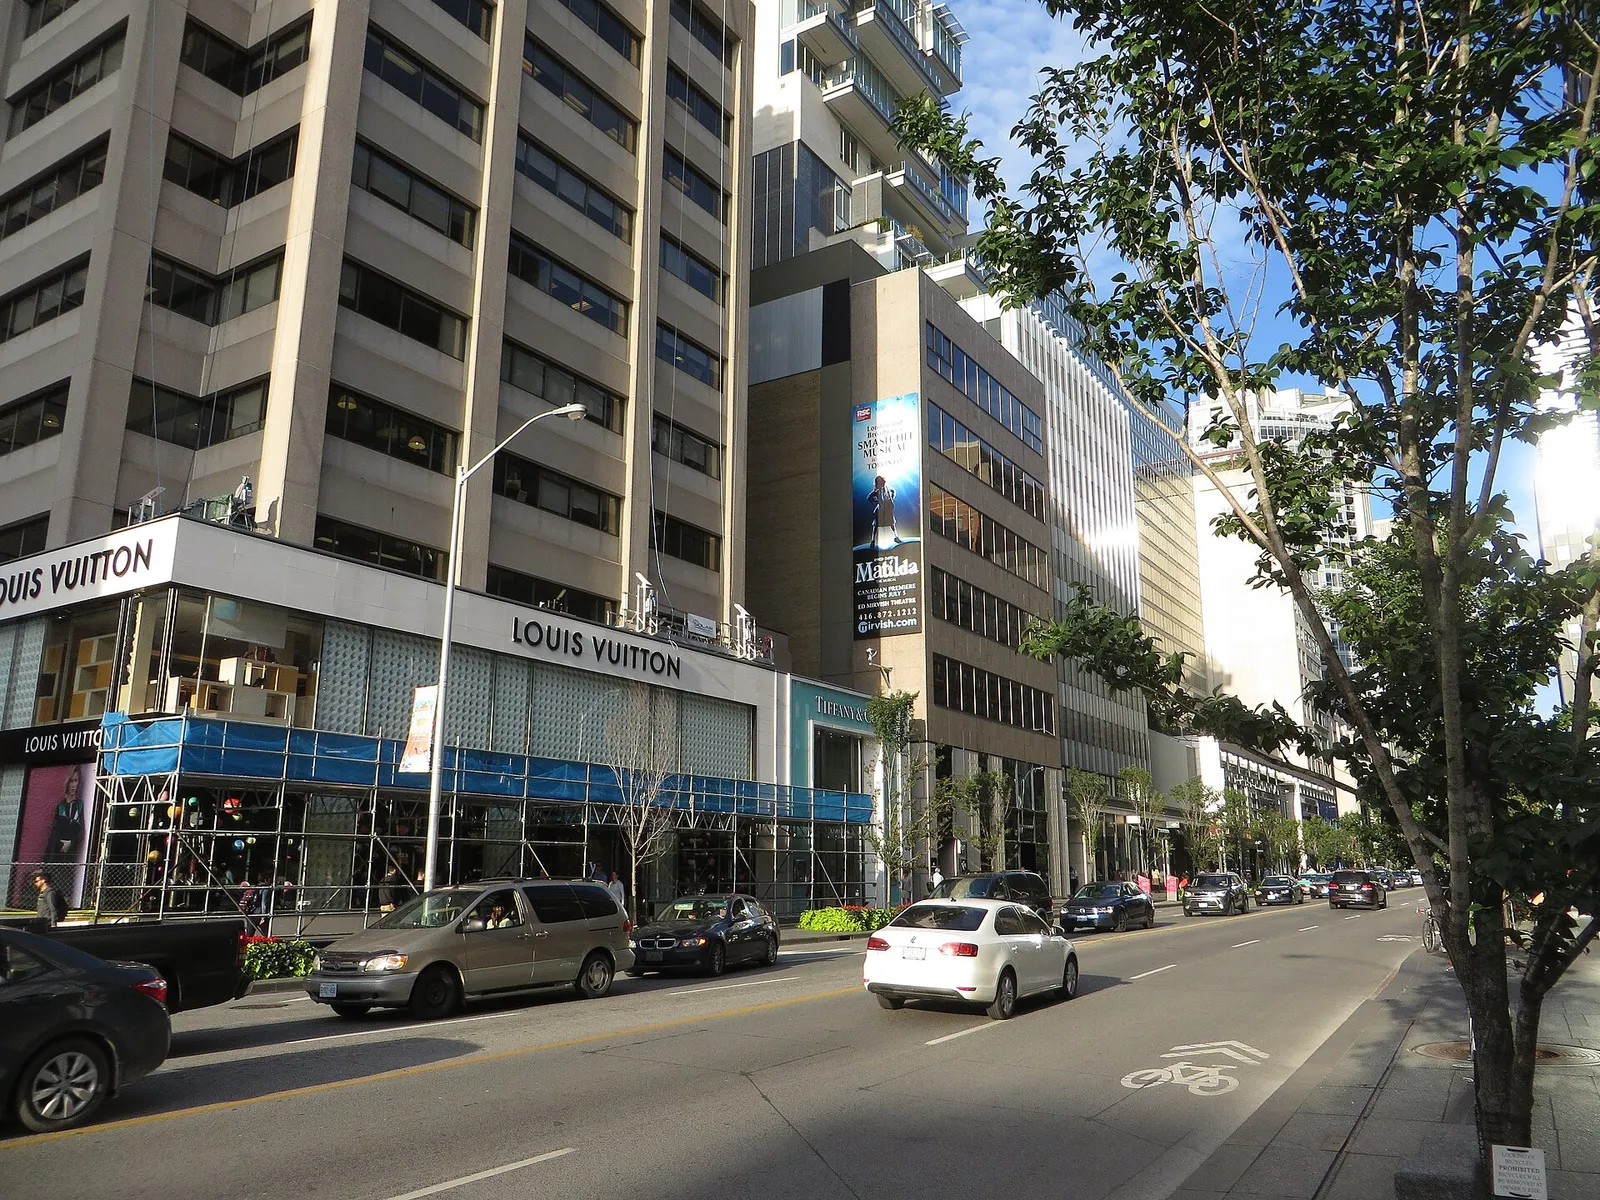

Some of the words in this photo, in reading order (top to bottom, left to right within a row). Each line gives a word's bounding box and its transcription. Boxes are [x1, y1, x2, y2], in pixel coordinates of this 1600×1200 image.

[51, 539, 153, 594] VUITTON
[855, 556, 919, 583] Matilda
[857, 587, 887, 596] CANADIAN
[888, 583, 916, 592] PREMIERE
[859, 607, 917, 620] 416.872.1212
[512, 617, 583, 656] LOUIS
[591, 636, 681, 679] VUITTON
[815, 695, 855, 720] TIFFANY
[25, 734, 58, 753] LOUIS
[62, 728, 114, 749] VUITTON
[1498, 1165, 1540, 1174] PROHIBITED
